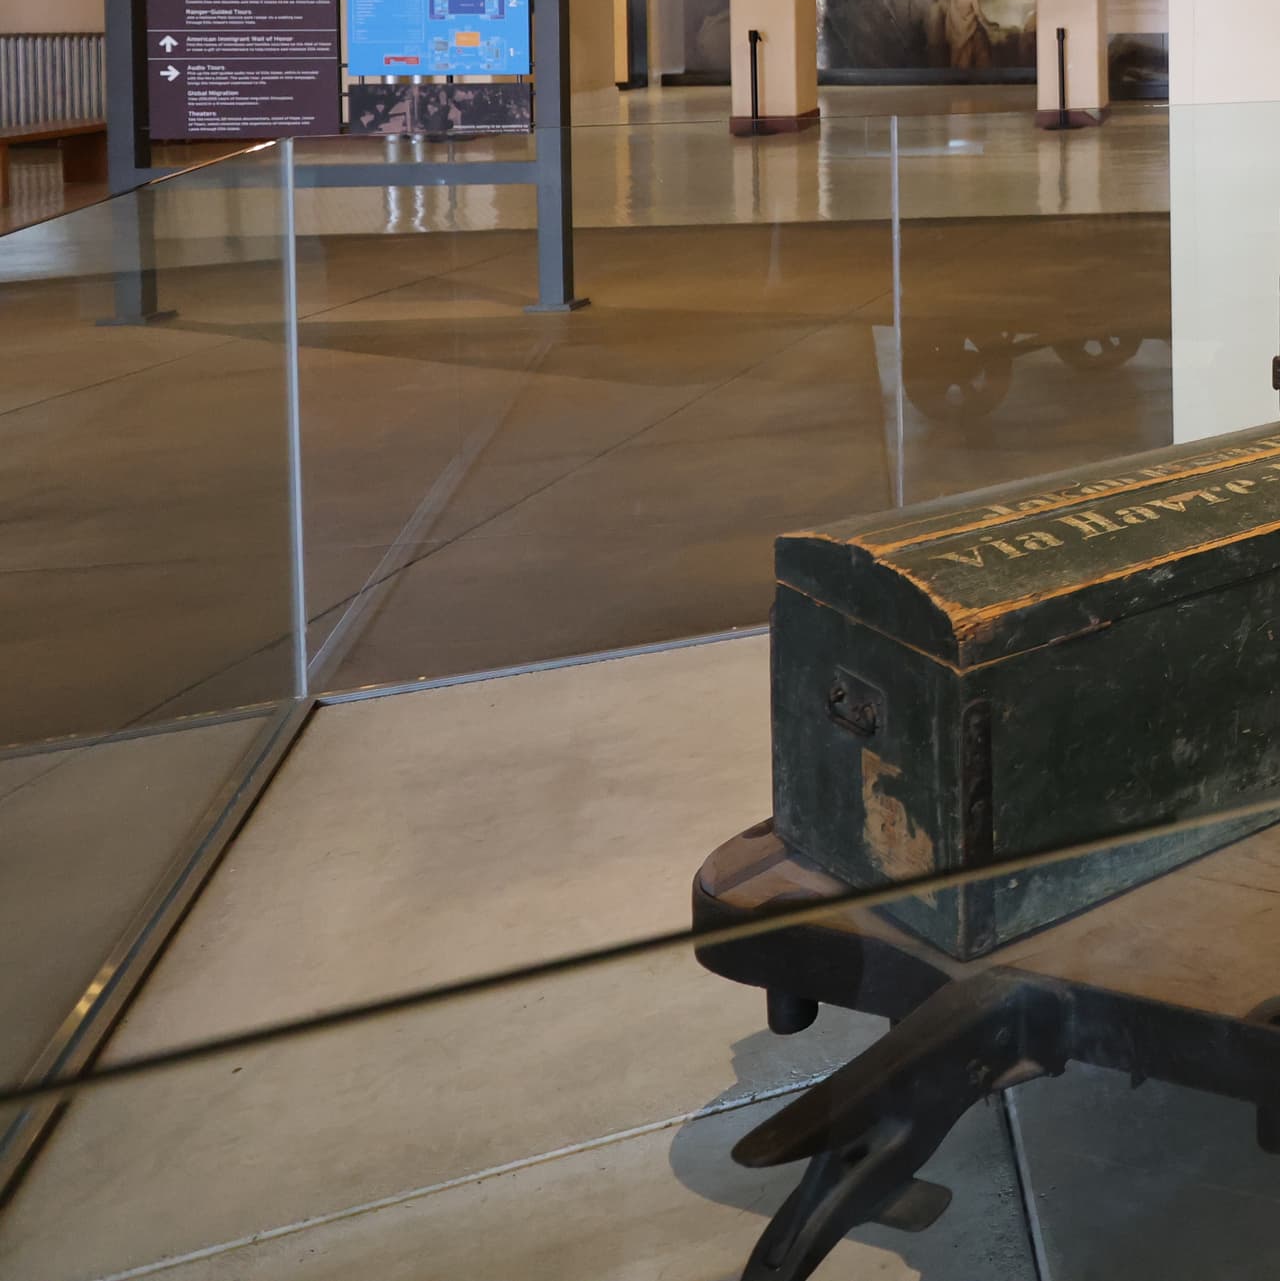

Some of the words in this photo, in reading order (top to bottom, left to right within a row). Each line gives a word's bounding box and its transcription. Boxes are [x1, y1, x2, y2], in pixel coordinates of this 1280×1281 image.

[509, 47, 515, 56] 1
[928, 531, 1064, 568] via
[1053, 479, 1255, 541] Havre
